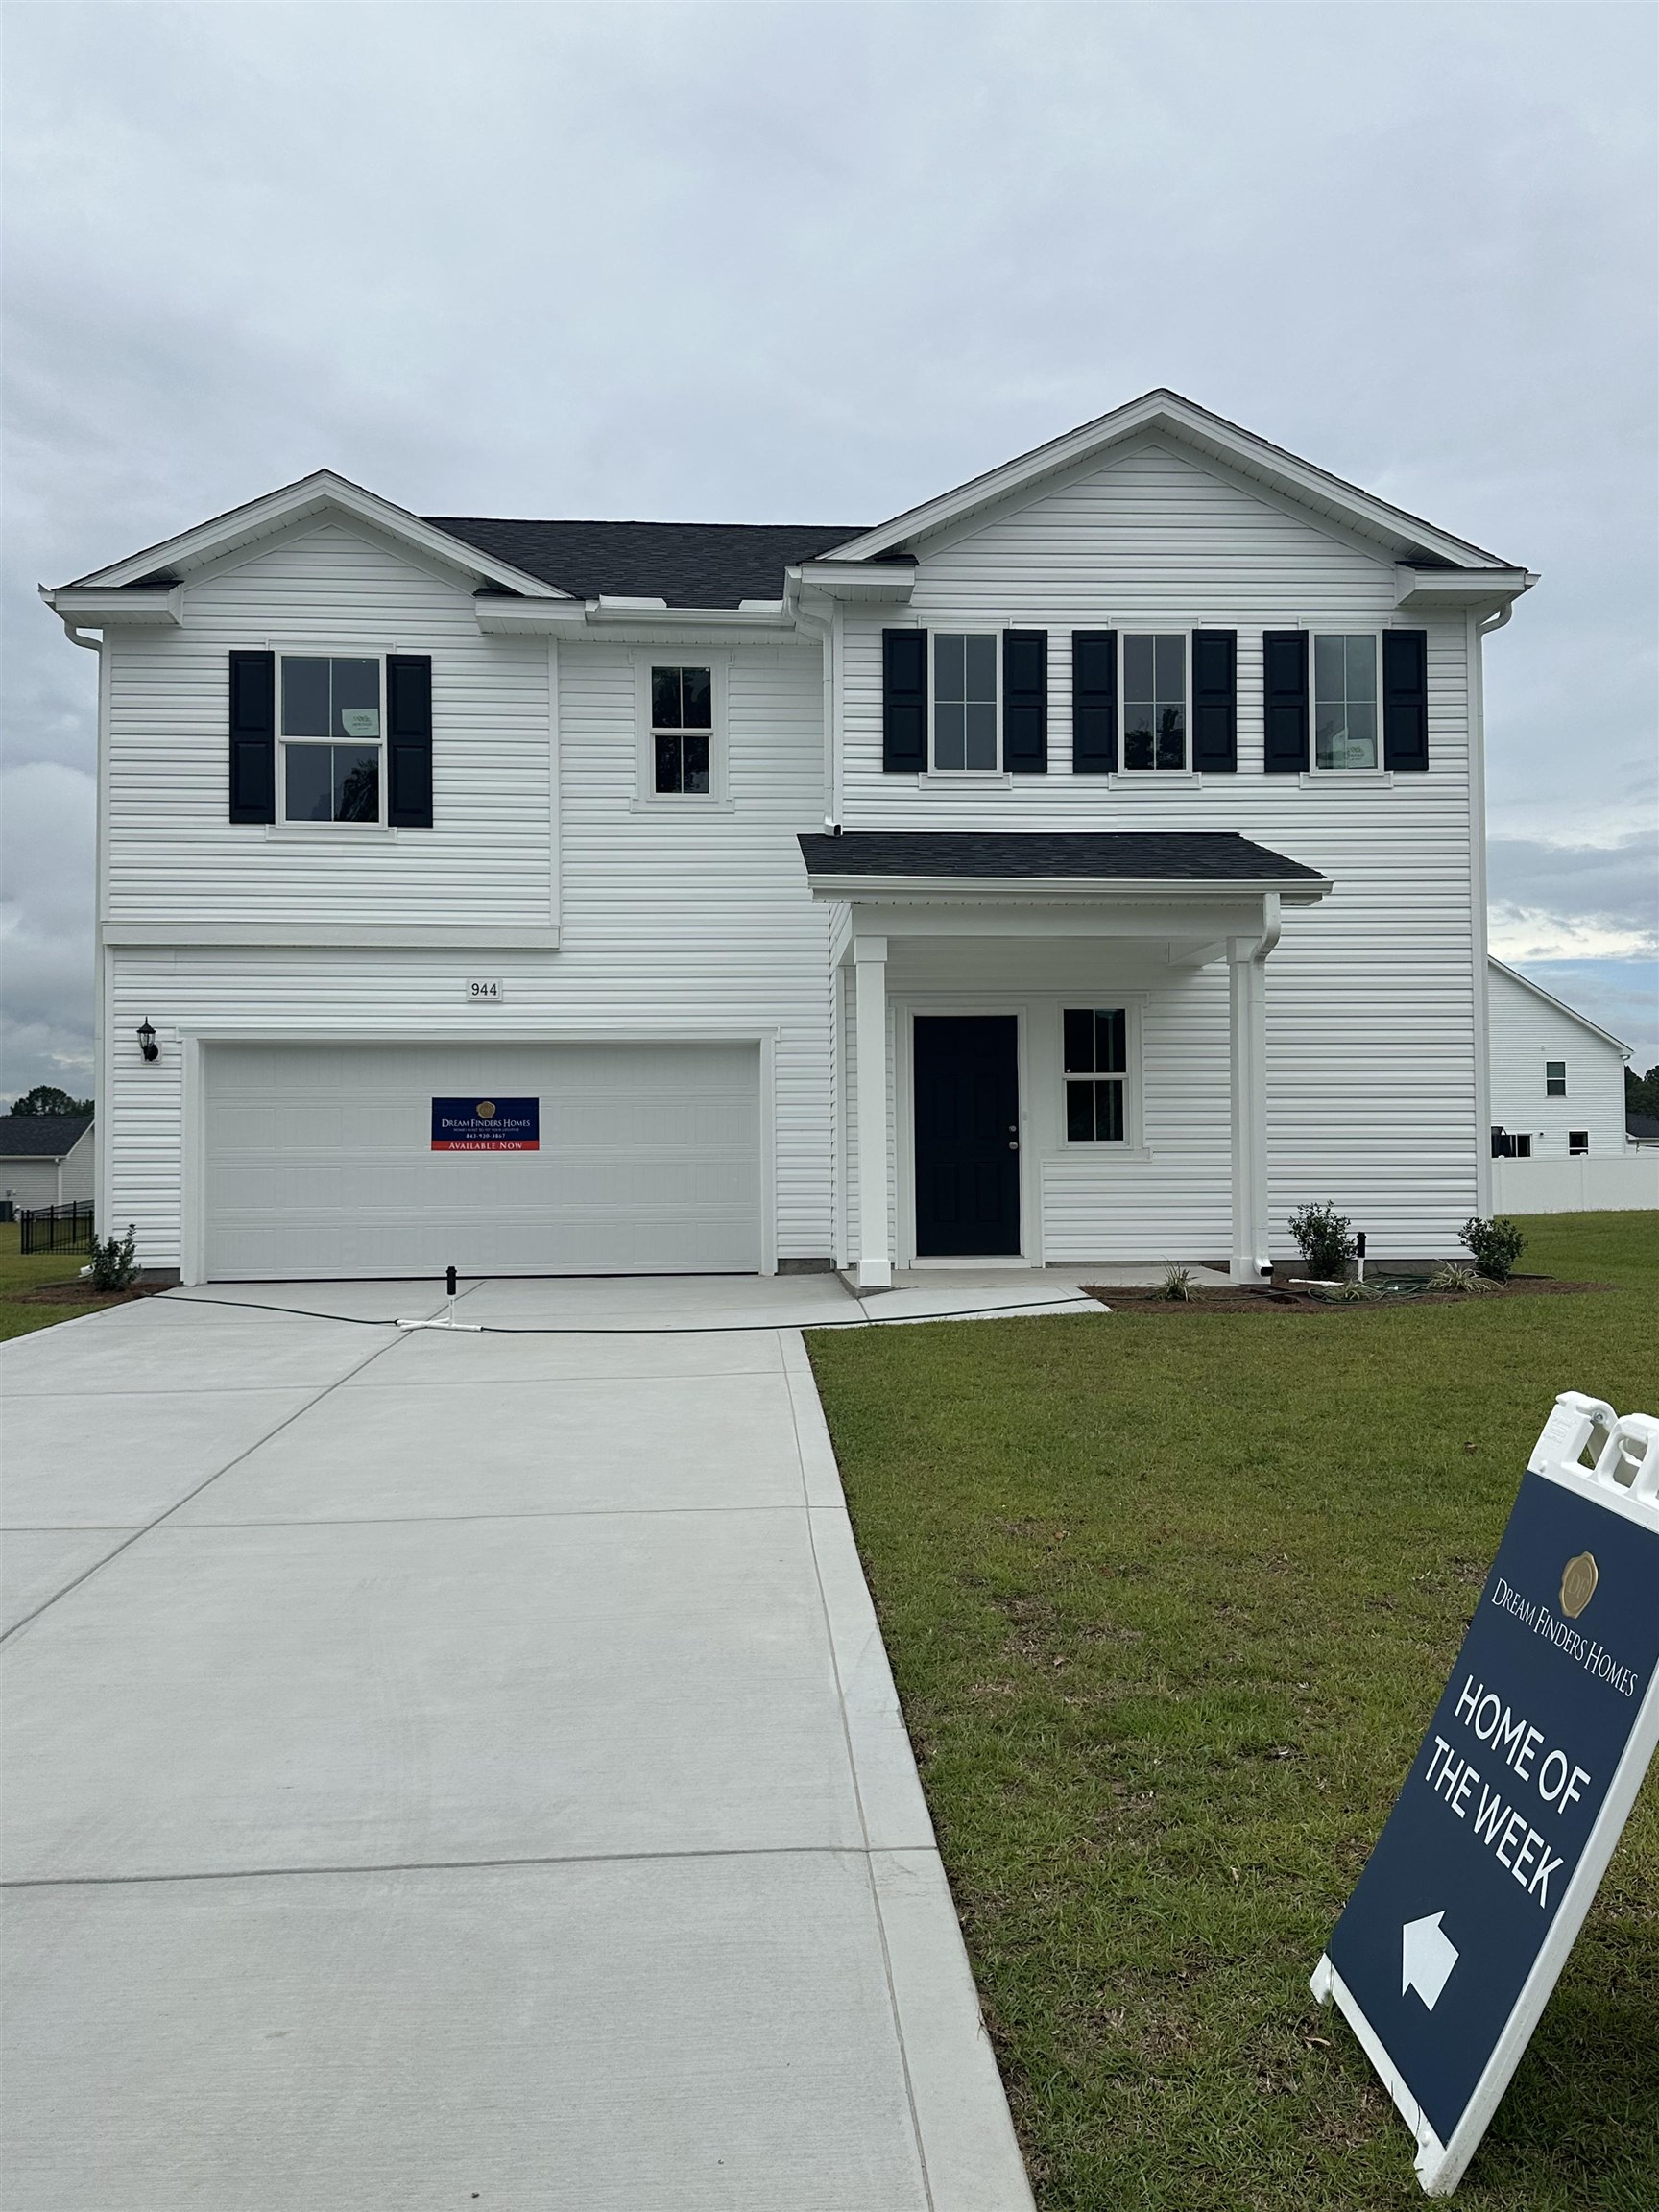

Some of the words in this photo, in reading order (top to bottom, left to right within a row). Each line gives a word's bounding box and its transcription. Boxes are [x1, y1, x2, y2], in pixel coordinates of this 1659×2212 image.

[471, 982, 497, 996] 944
[442, 1118, 469, 1127] DREAM
[470, 1118, 502, 1127] FINDERS
[503, 1118, 530, 1127] HOMES
[1491, 1577, 1536, 1626] DREAM
[1533, 1606, 1588, 1661] FINDERS
[1584, 1641, 1639, 1697] HOMES
[1455, 1674, 1545, 1782] HOME
[1539, 1749, 1592, 1815] OF
[1425, 1735, 1481, 1819] THE
[1473, 1783, 1565, 1910] WEEK
